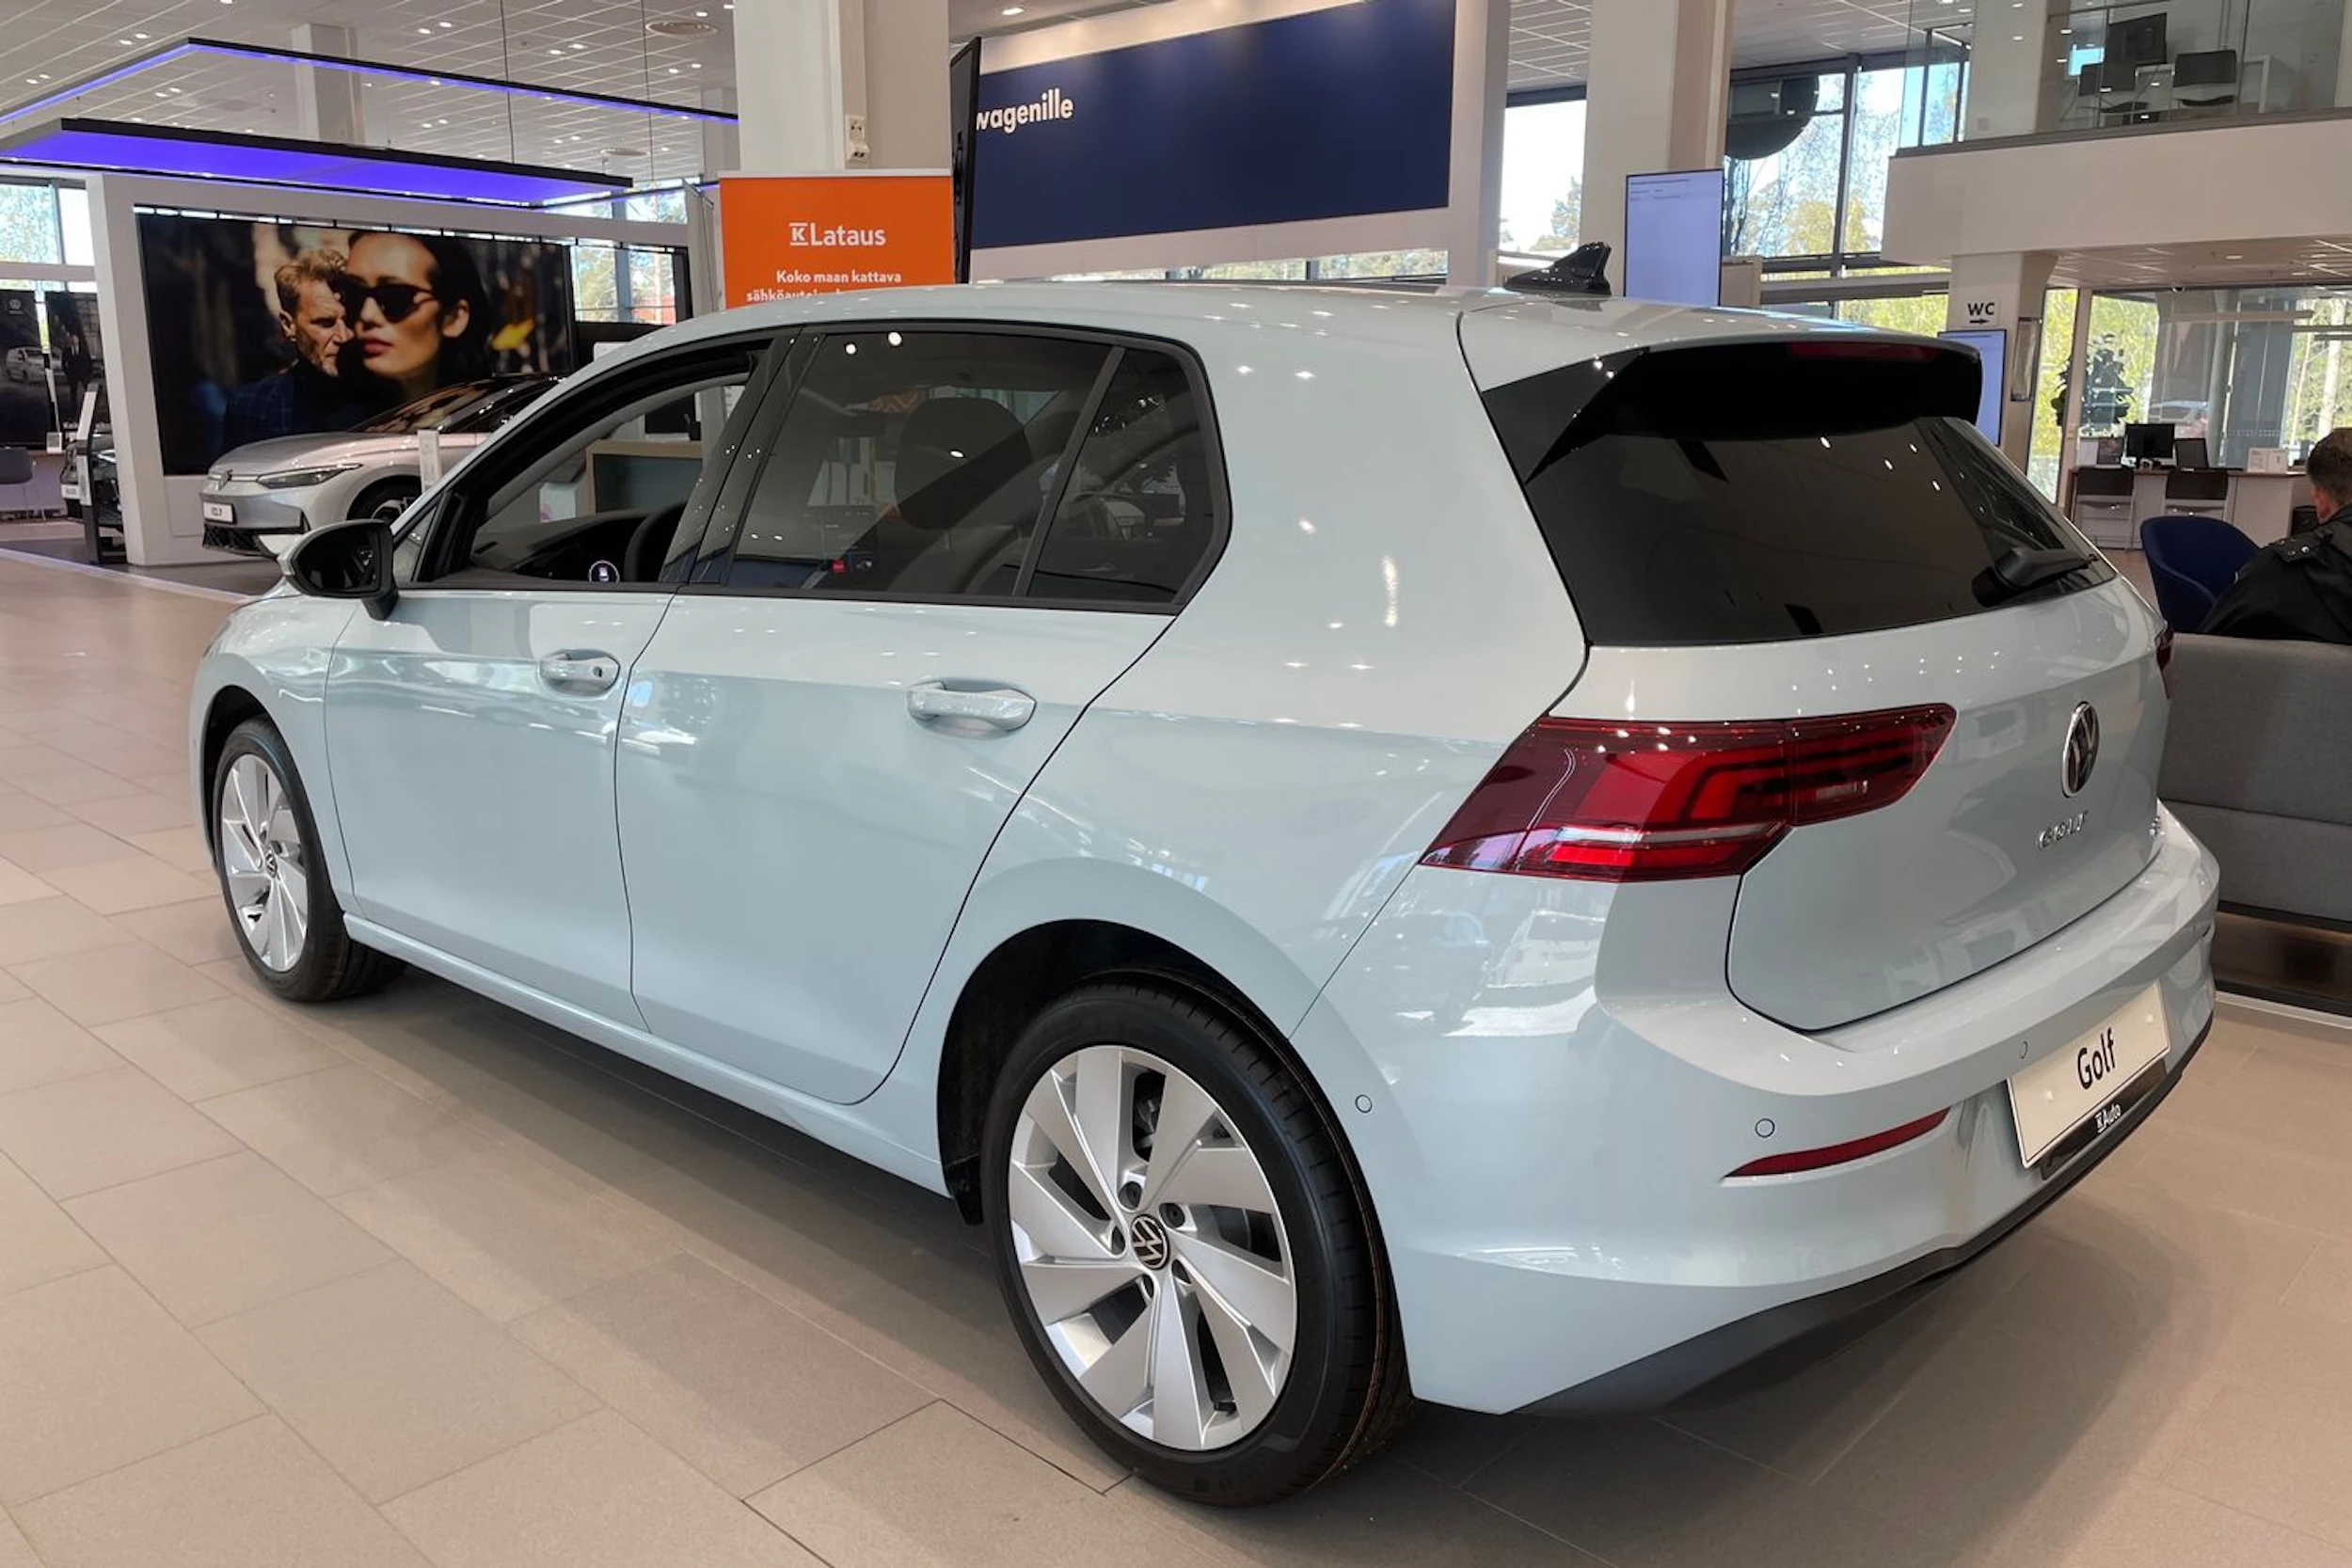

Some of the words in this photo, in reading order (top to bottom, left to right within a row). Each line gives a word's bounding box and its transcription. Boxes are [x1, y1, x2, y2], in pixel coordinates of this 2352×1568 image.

[776, 270, 811, 283] Koko
[814, 273, 849, 283] maan
[851, 270, 901, 283] kattava
[1968, 302, 1994, 316] WC
[2077, 1027, 2116, 1089] Golf
